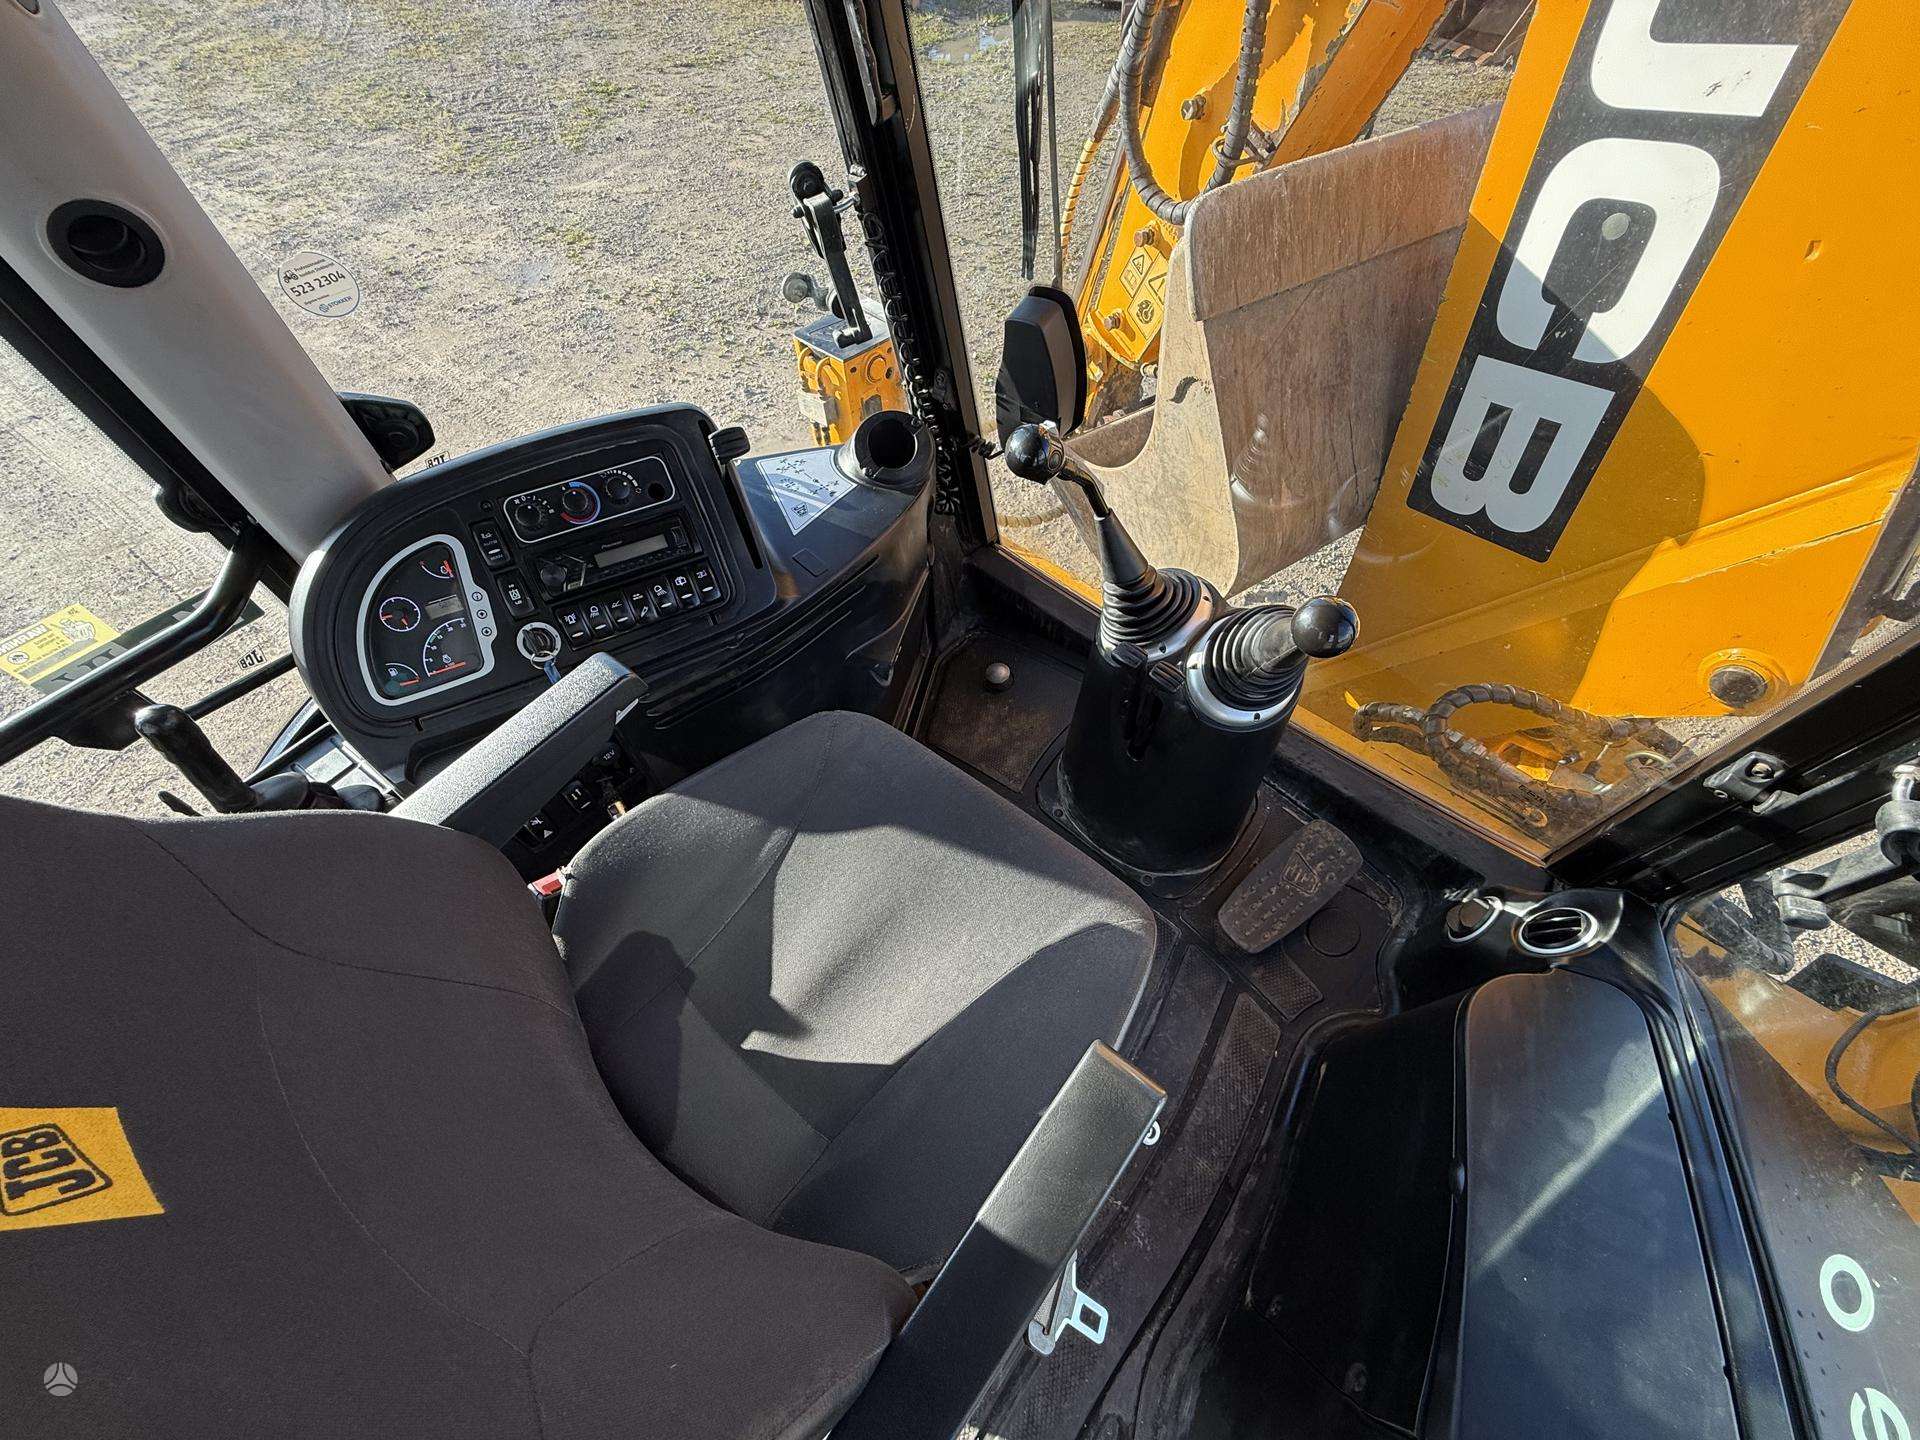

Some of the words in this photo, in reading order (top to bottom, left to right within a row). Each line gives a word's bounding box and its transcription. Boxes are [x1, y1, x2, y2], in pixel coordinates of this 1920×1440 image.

[290, 281, 315, 297] 523
[313, 270, 346, 289] 2304
[1430, 0, 1799, 533] JCB
[1, 1131, 96, 1200] JCB
